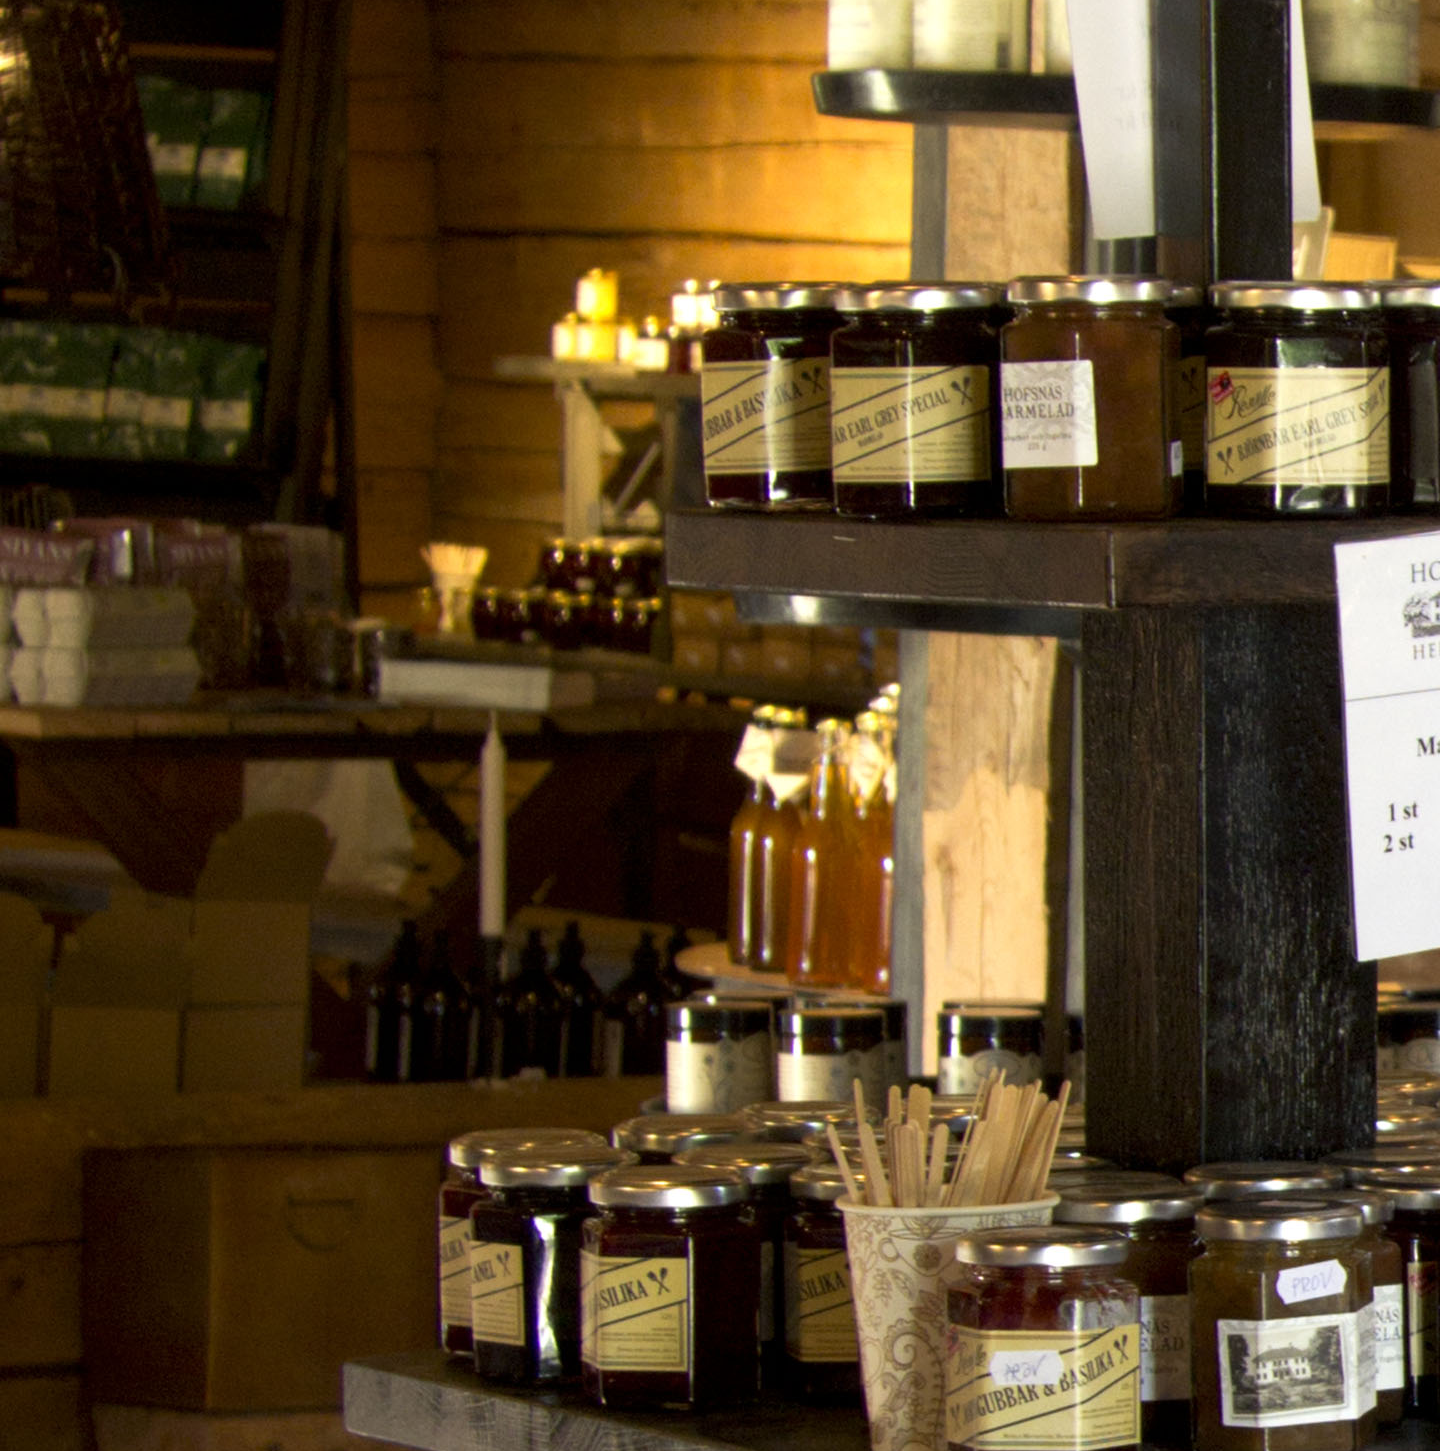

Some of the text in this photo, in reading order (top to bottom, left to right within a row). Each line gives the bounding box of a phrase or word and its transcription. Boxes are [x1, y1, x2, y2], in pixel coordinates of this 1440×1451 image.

[849, 415, 874, 440] EARL
[874, 403, 899, 429] GREY
[901, 388, 950, 418] SPECIAL
[1002, 403, 1075, 420] ARMELAD
[1292, 417, 1326, 440] EARL
[1325, 406, 1358, 429] GREY
[1388, 801, 1418, 823] 1 st
[1383, 832, 1414, 854] 2 st
[1292, 1267, 1333, 1297] PROV
[1044, 1380, 1056, 1398] &
